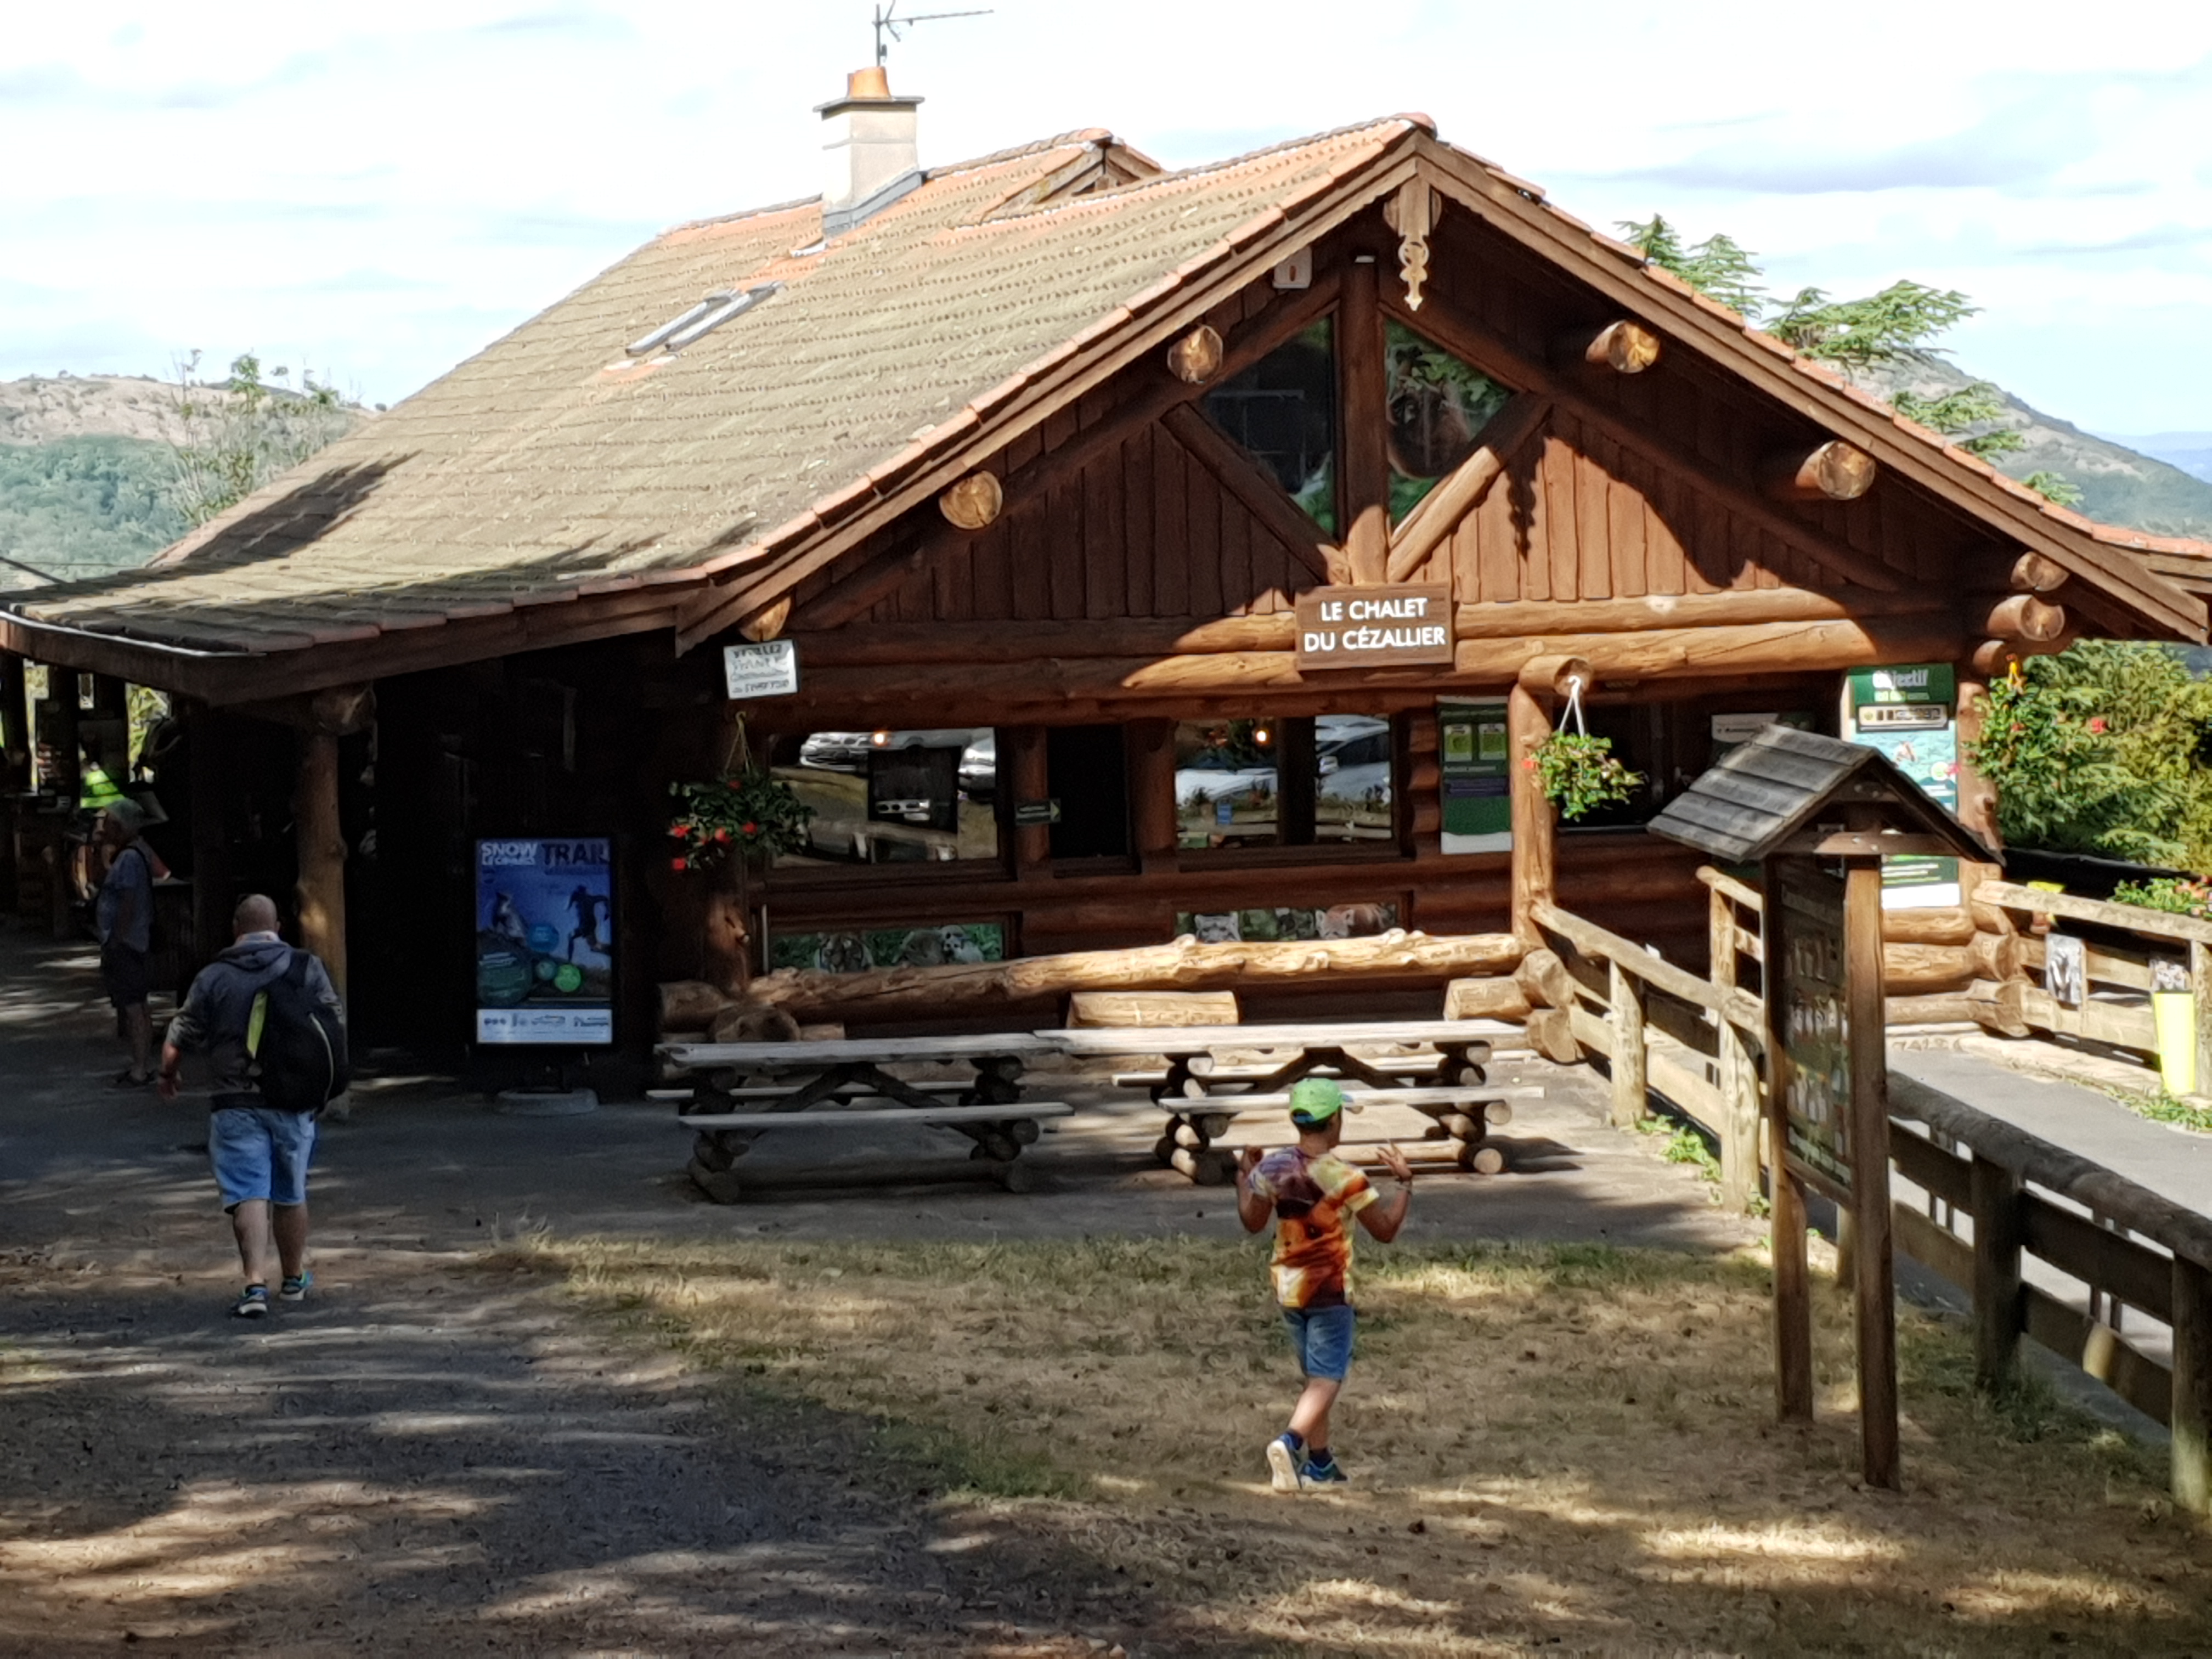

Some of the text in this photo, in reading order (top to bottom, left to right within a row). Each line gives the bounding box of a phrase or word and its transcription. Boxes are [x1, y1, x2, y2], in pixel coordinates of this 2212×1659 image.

[1321, 597, 1427, 621] LE CHALET
[1304, 625, 1446, 652] DU CÉZALLIER
[481, 842, 538, 856] SNOW
